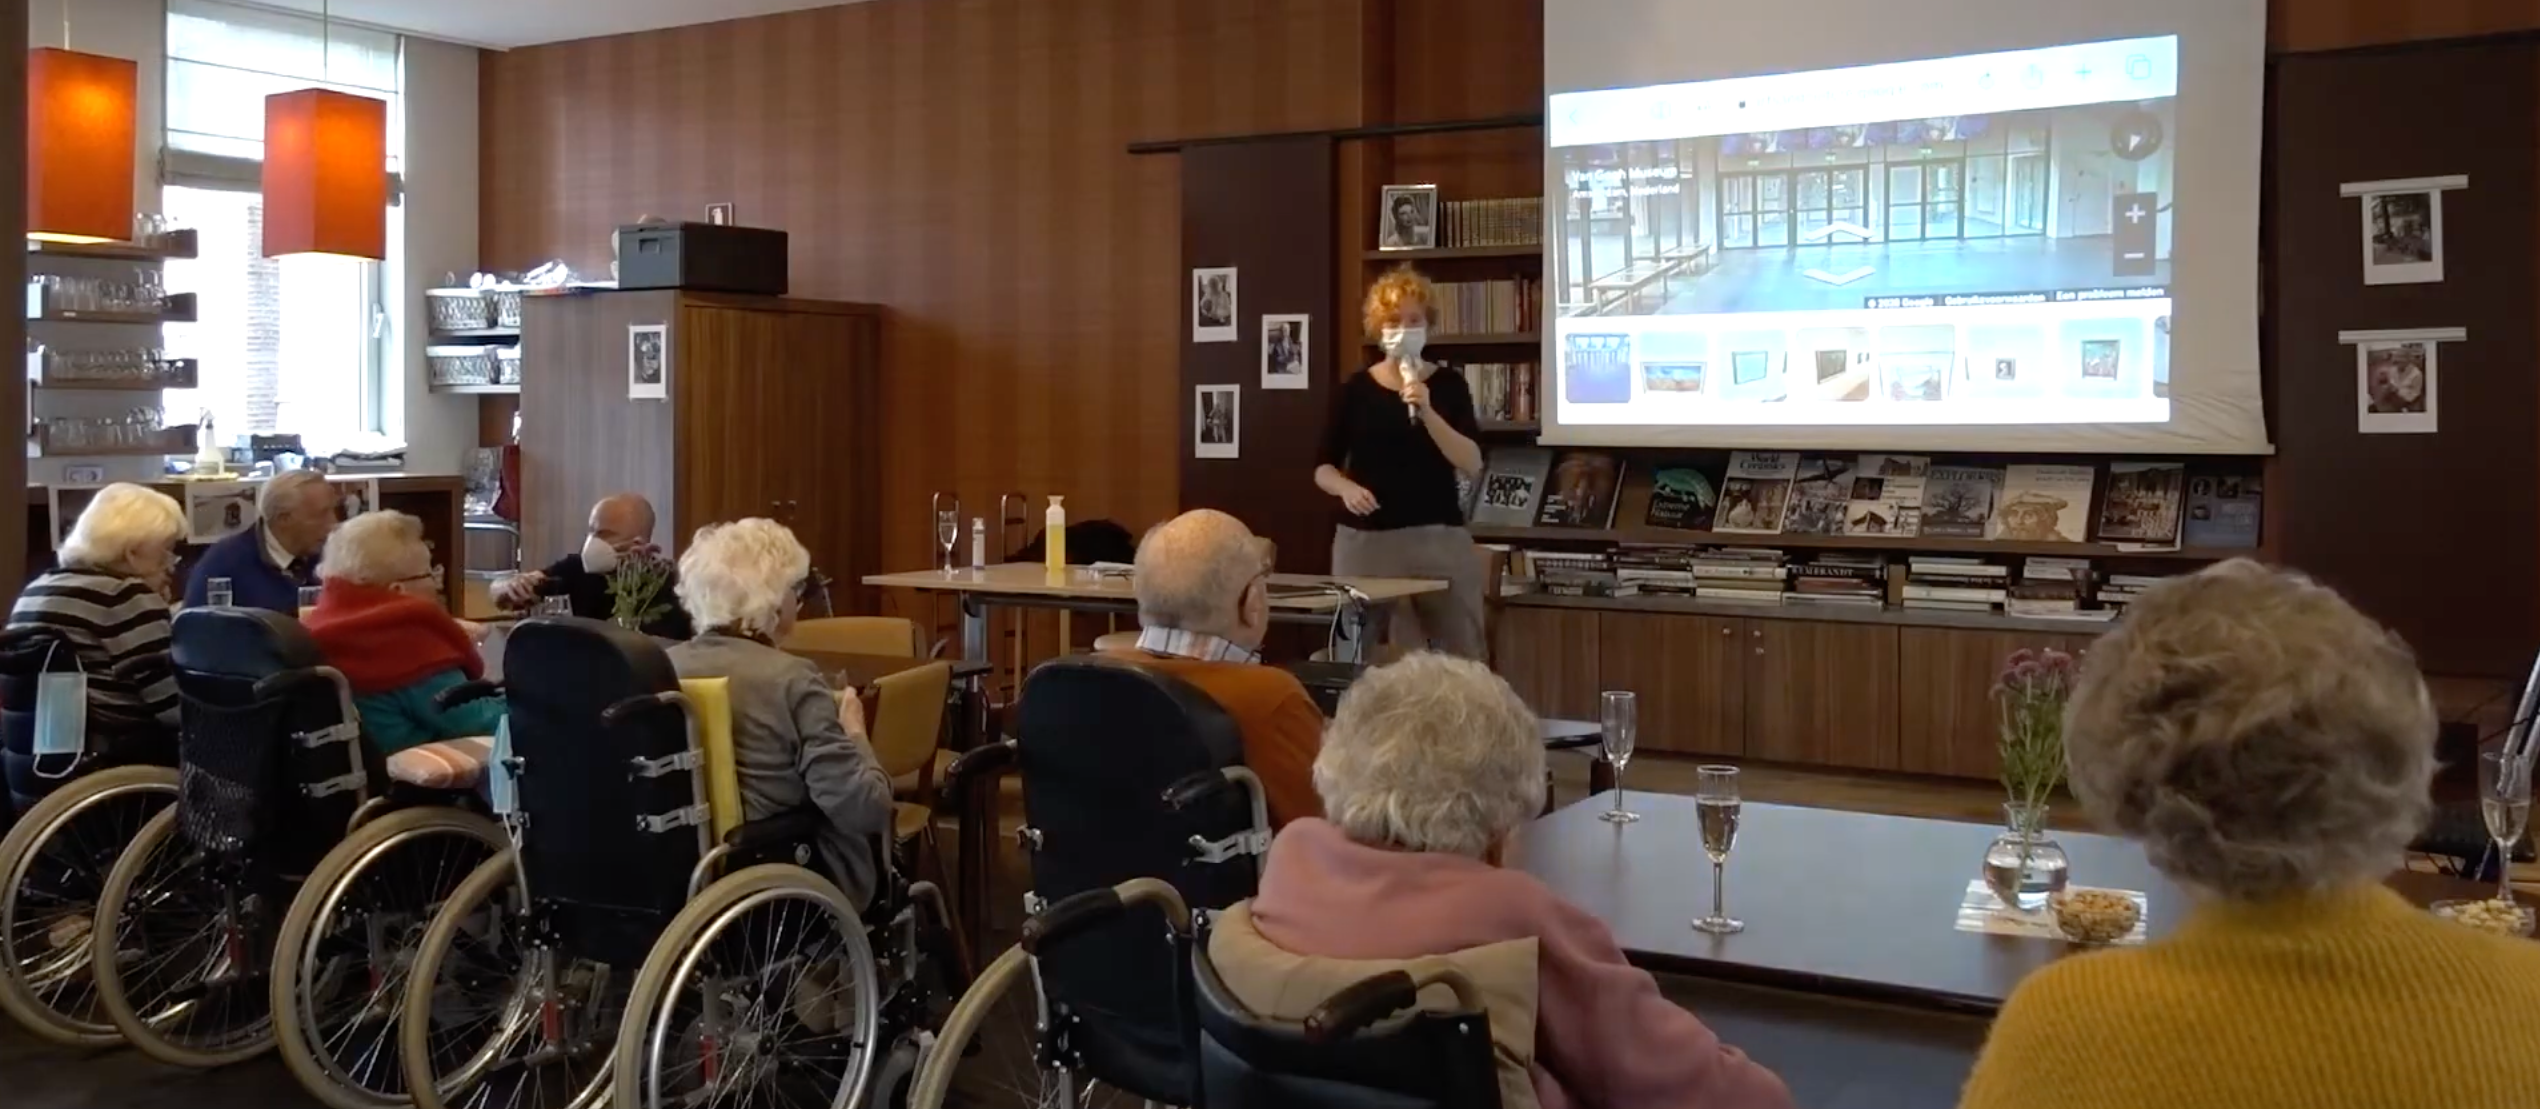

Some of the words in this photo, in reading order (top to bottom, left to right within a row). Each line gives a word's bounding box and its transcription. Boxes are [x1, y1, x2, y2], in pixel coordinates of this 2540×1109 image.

[1571, 170, 1592, 182] Van
[1628, 167, 1678, 180] Museum
[1572, 188, 1628, 199] Amsdam,
[1629, 183, 1680, 196] Nederland
[1901, 297, 1934, 308] Google
[2056, 290, 2076, 301] Een
[2077, 288, 2125, 301] probleem
[2125, 286, 2165, 298] melden
[1791, 566, 1854, 577] REMBRANDT
